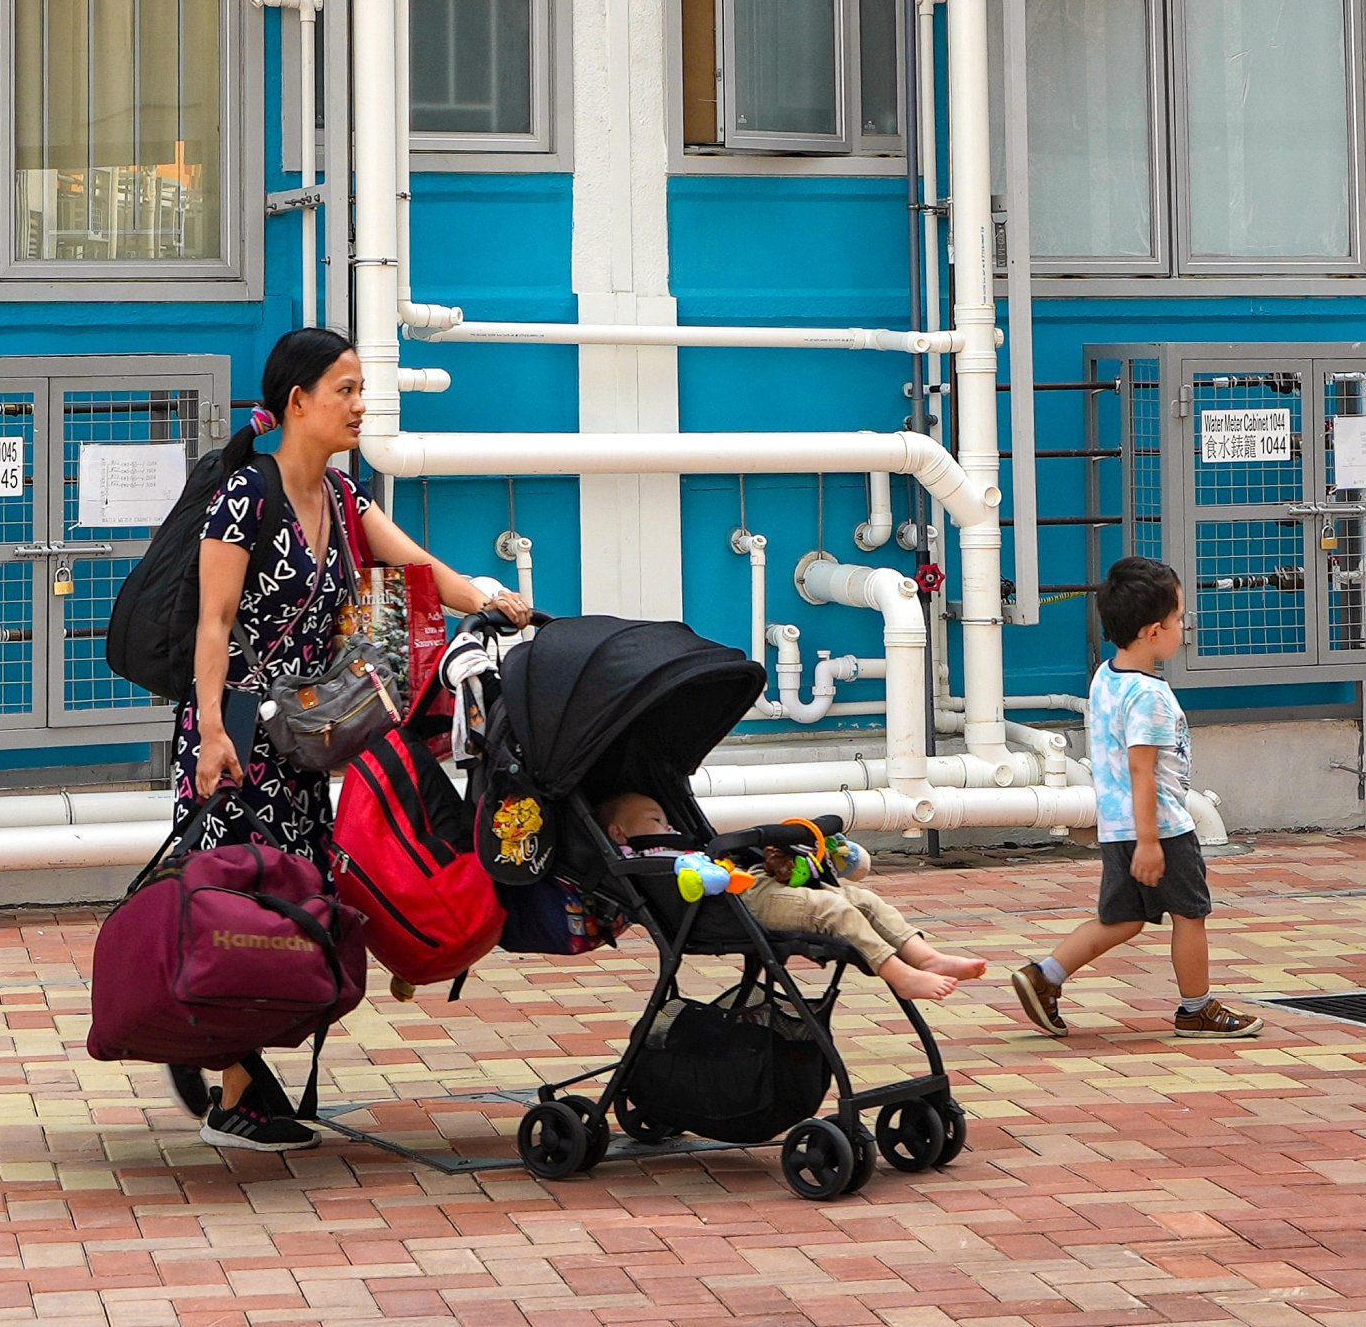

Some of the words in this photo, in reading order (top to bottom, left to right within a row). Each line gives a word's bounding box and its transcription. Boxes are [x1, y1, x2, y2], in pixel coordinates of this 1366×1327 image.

[1204, 414, 1223, 432] Water
[1224, 413, 1243, 432] Meter
[1243, 413, 1269, 432] Cabinet
[1269, 413, 1285, 431] 1044
[1260, 436, 1287, 454] 1044
